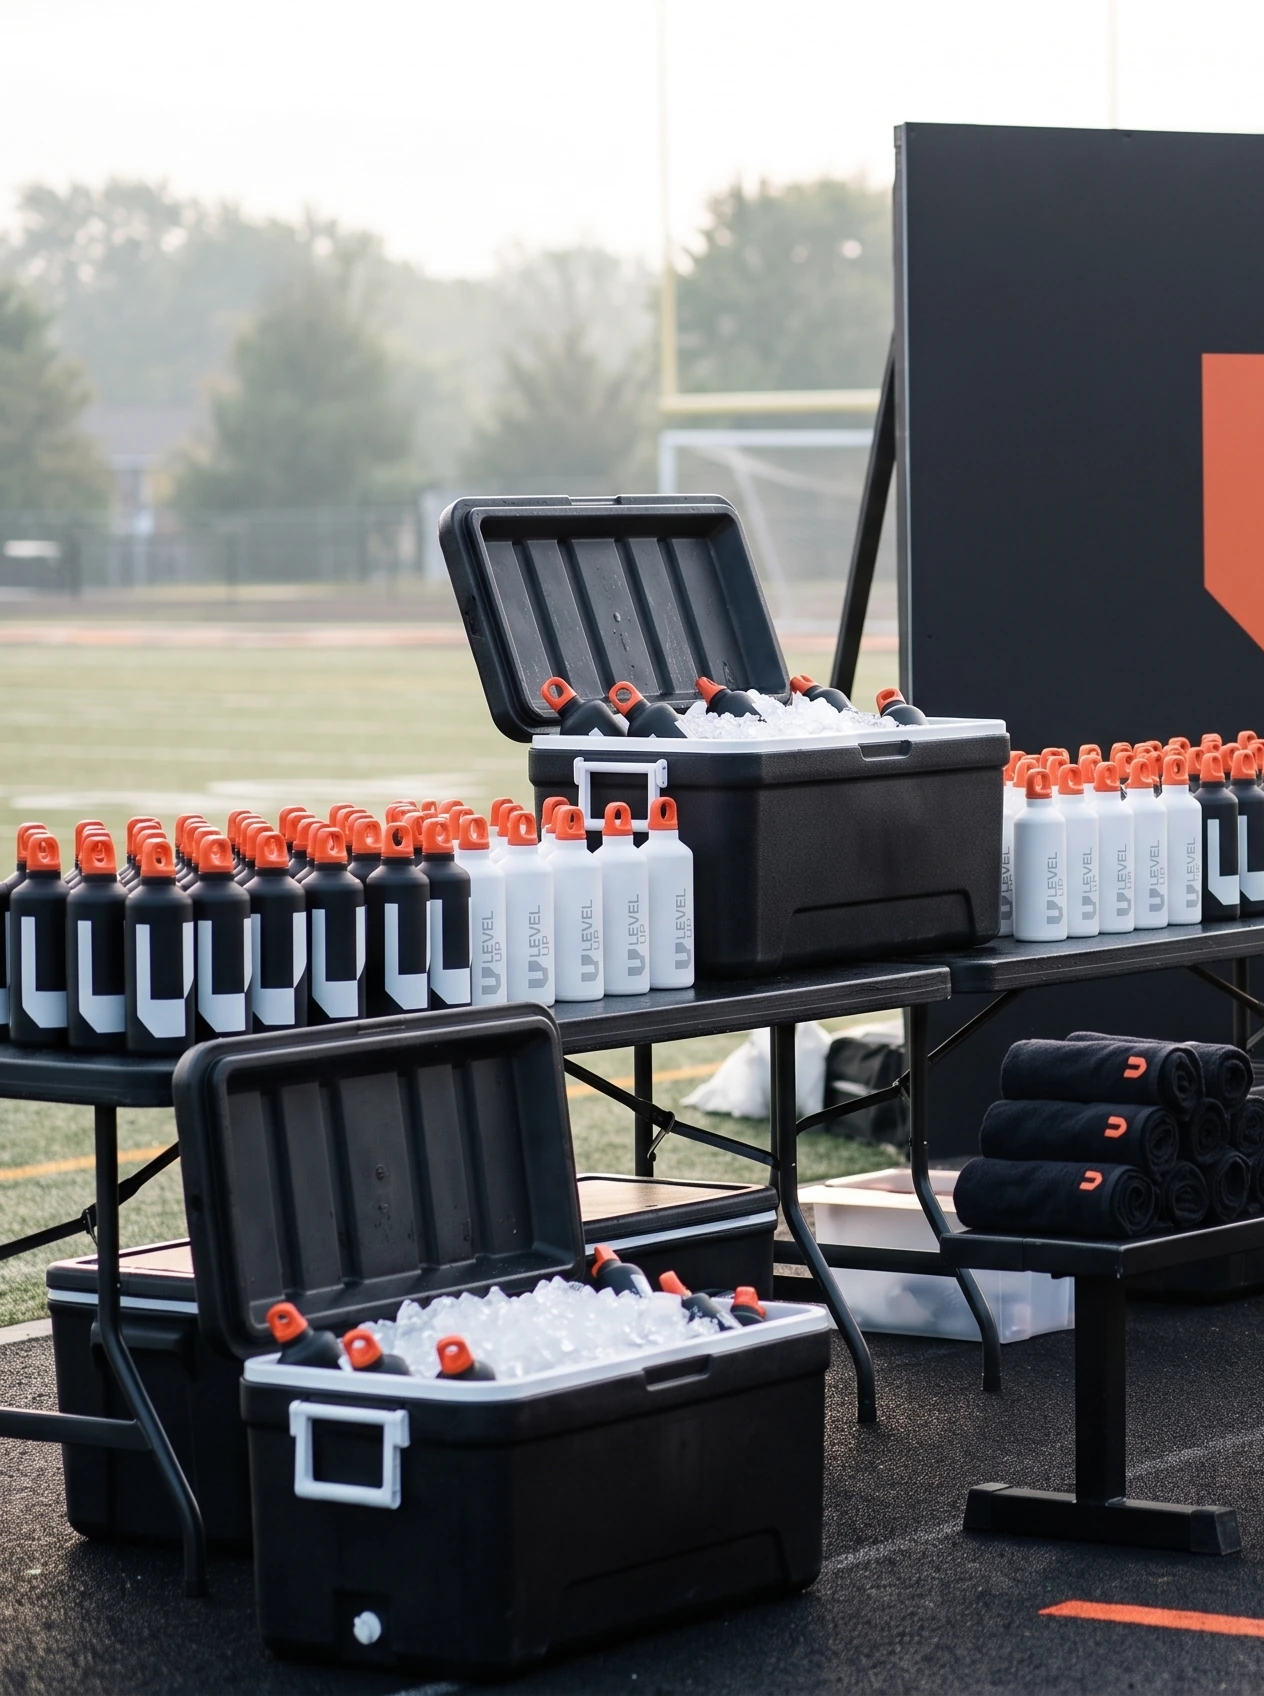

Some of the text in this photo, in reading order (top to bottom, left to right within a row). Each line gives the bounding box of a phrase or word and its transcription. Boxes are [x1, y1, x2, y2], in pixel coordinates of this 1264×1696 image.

[1047, 852, 1057, 897] LEVEL
[1082, 847, 1093, 893] LEVEL
[1117, 843, 1127, 890] LEVEL
[1150, 840, 1160, 886] LEVEL
[1186, 837, 1196, 882] LEVEL
[482, 910, 494, 963] LEVEL
[529, 905, 541, 957] LEVEL
[581, 899, 593, 951] LEVEL
[628, 893, 639, 945] LEVEL
[639, 924, 646, 944] UP
[675, 888, 686, 939] LEVEL
[494, 941, 502, 962] UP
[542, 935, 549, 956] UP
[593, 930, 600, 950] UP
